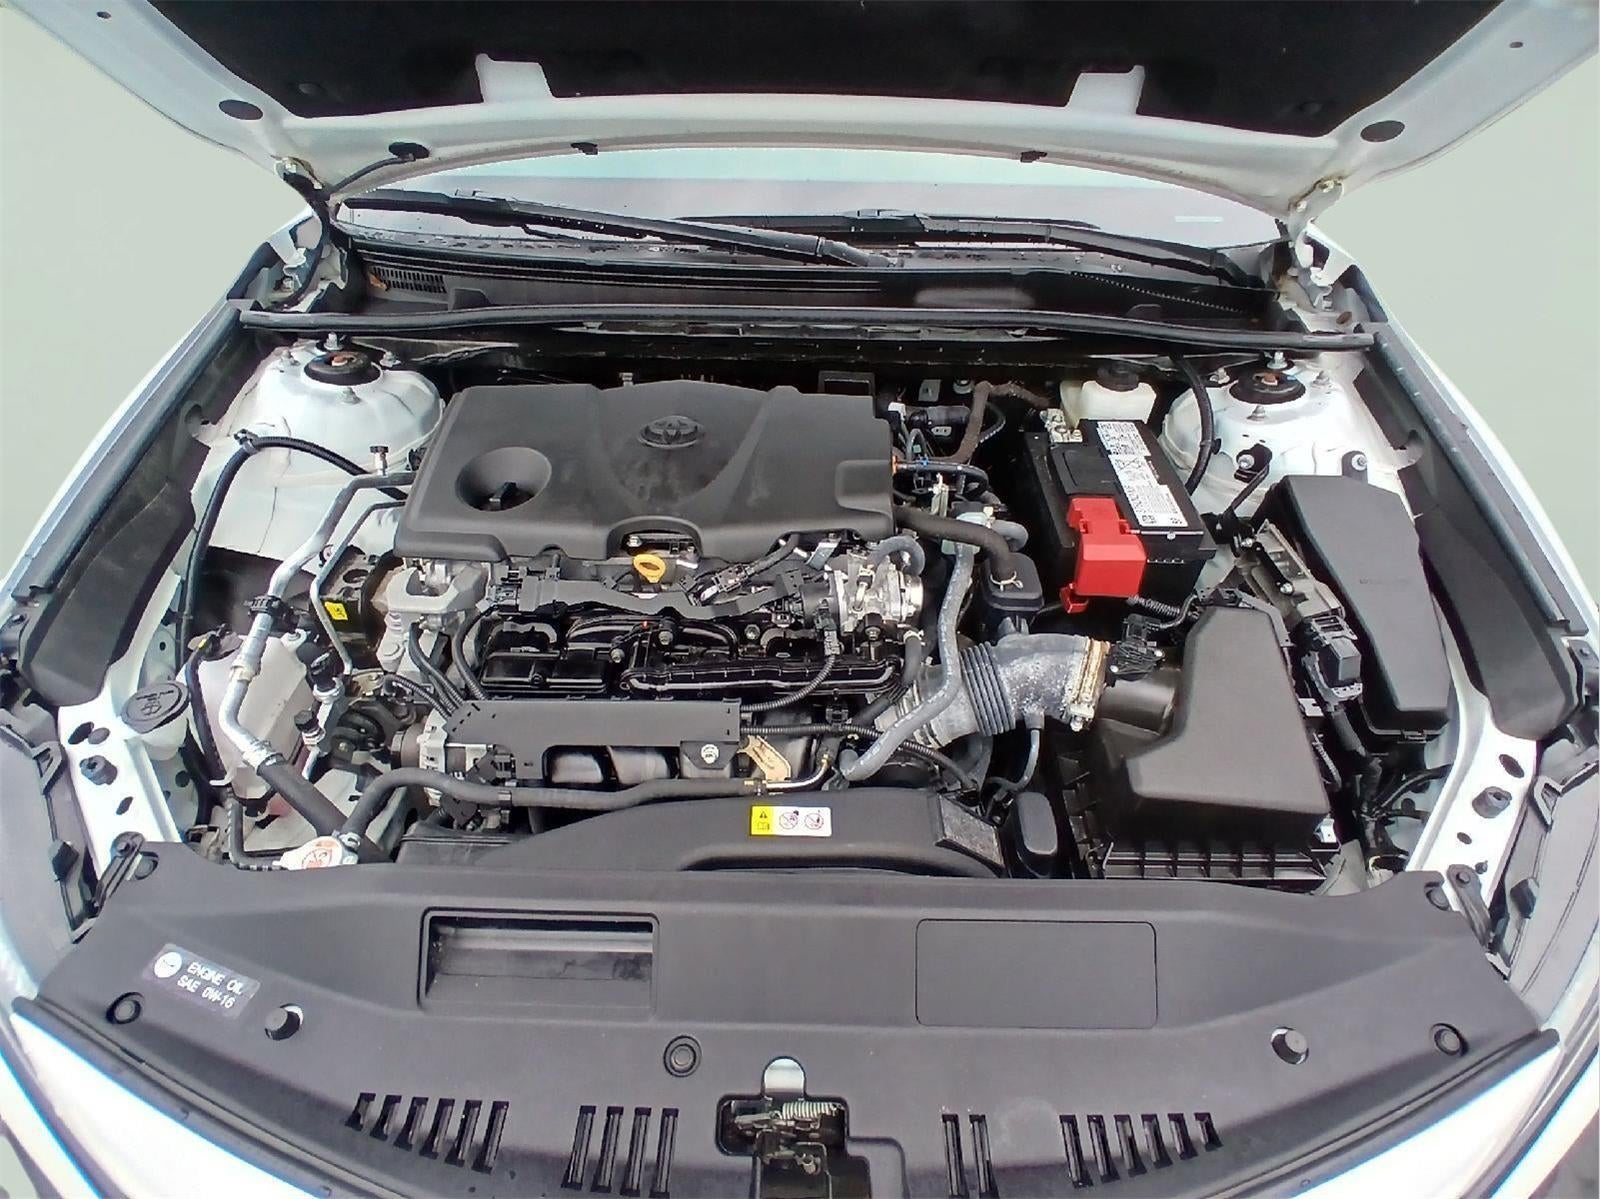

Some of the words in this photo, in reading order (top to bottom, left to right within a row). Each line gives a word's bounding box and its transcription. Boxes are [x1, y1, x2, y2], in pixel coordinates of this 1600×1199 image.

[177, 974, 201, 993] SAE
[201, 986, 236, 1009] 0W-16
[187, 961, 226, 986] ENGINE
[226, 979, 243, 995] OIL
